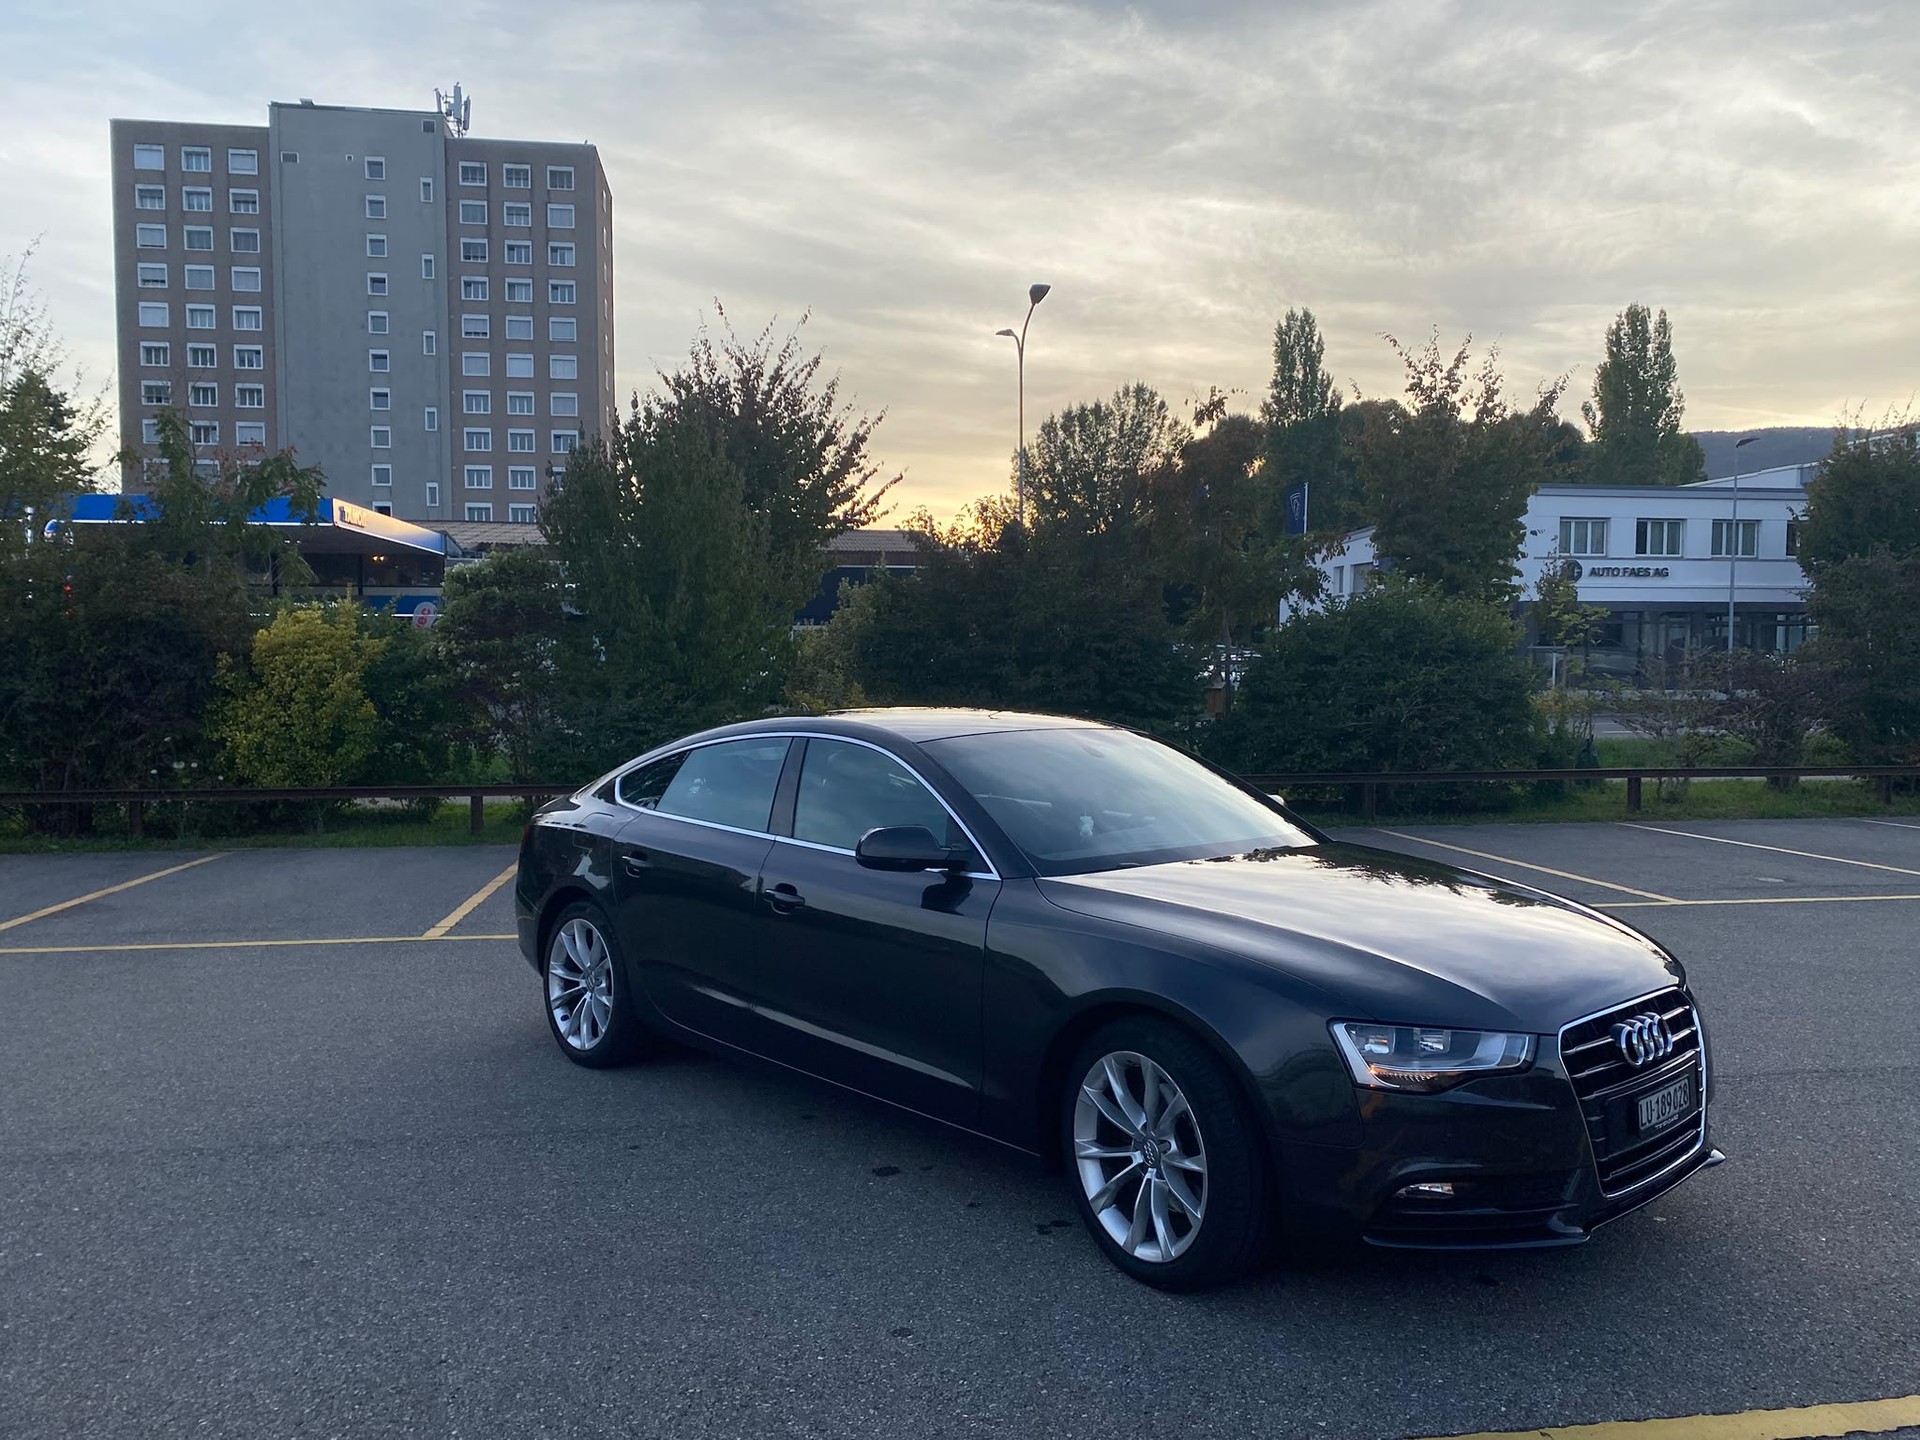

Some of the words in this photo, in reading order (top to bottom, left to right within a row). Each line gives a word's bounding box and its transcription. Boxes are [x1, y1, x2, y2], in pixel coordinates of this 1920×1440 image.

[1589, 567, 1621, 577] AUTO
[1622, 567, 1651, 577] FAES
[1653, 567, 1669, 577] AG
